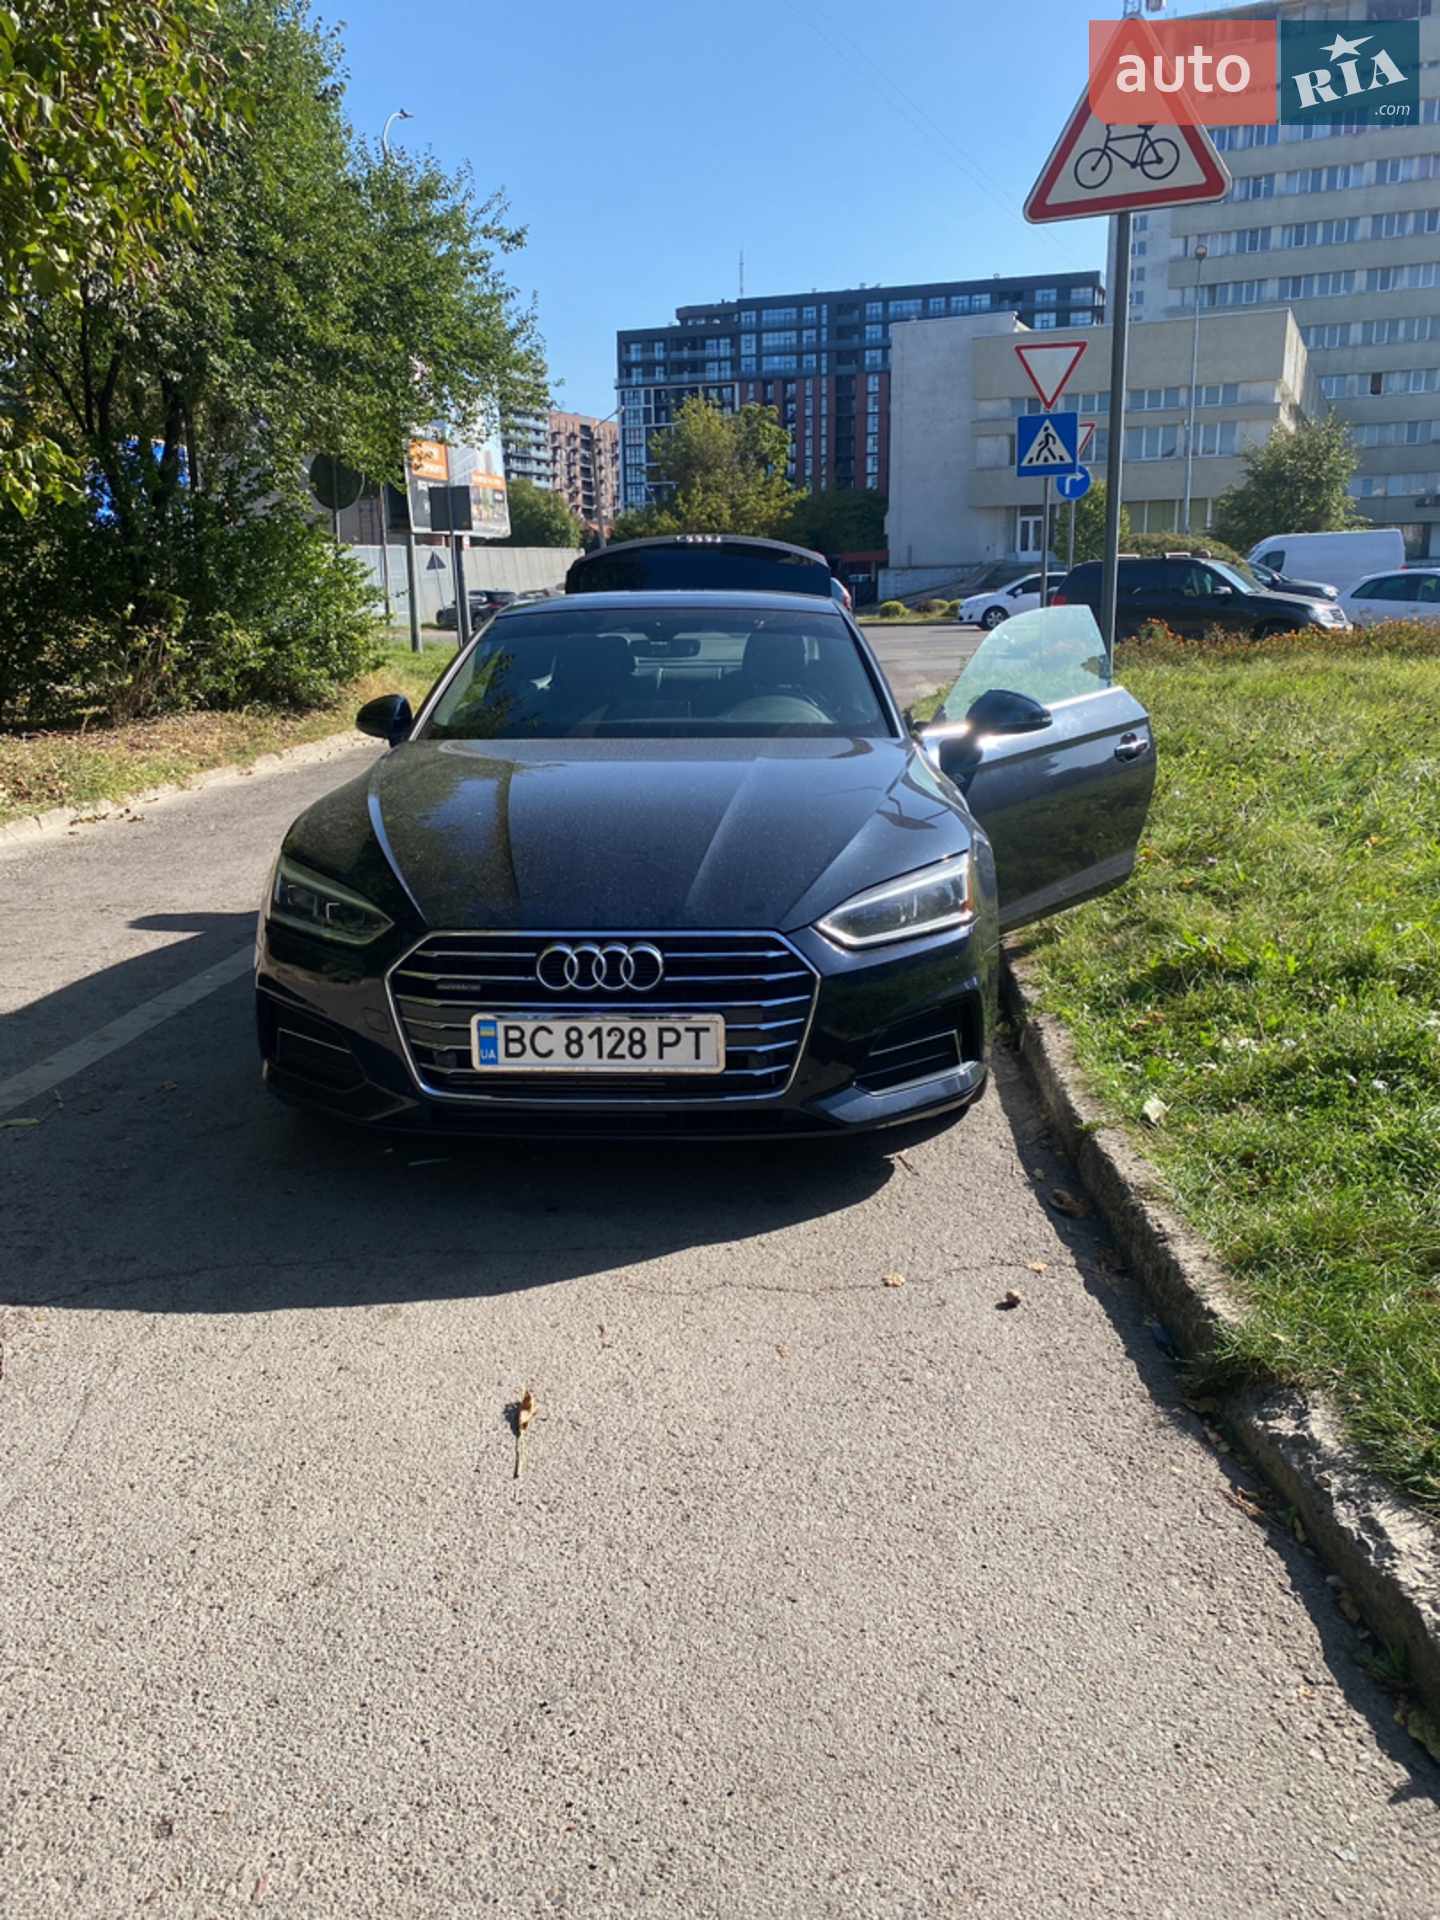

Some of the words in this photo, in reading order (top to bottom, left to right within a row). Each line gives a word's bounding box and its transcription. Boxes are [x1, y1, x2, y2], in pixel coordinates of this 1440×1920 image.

[503, 1025, 554, 1059] BC
[564, 1026, 647, 1060] 8128
[657, 1027, 711, 1060] PT
[480, 1049, 497, 1060] UA
